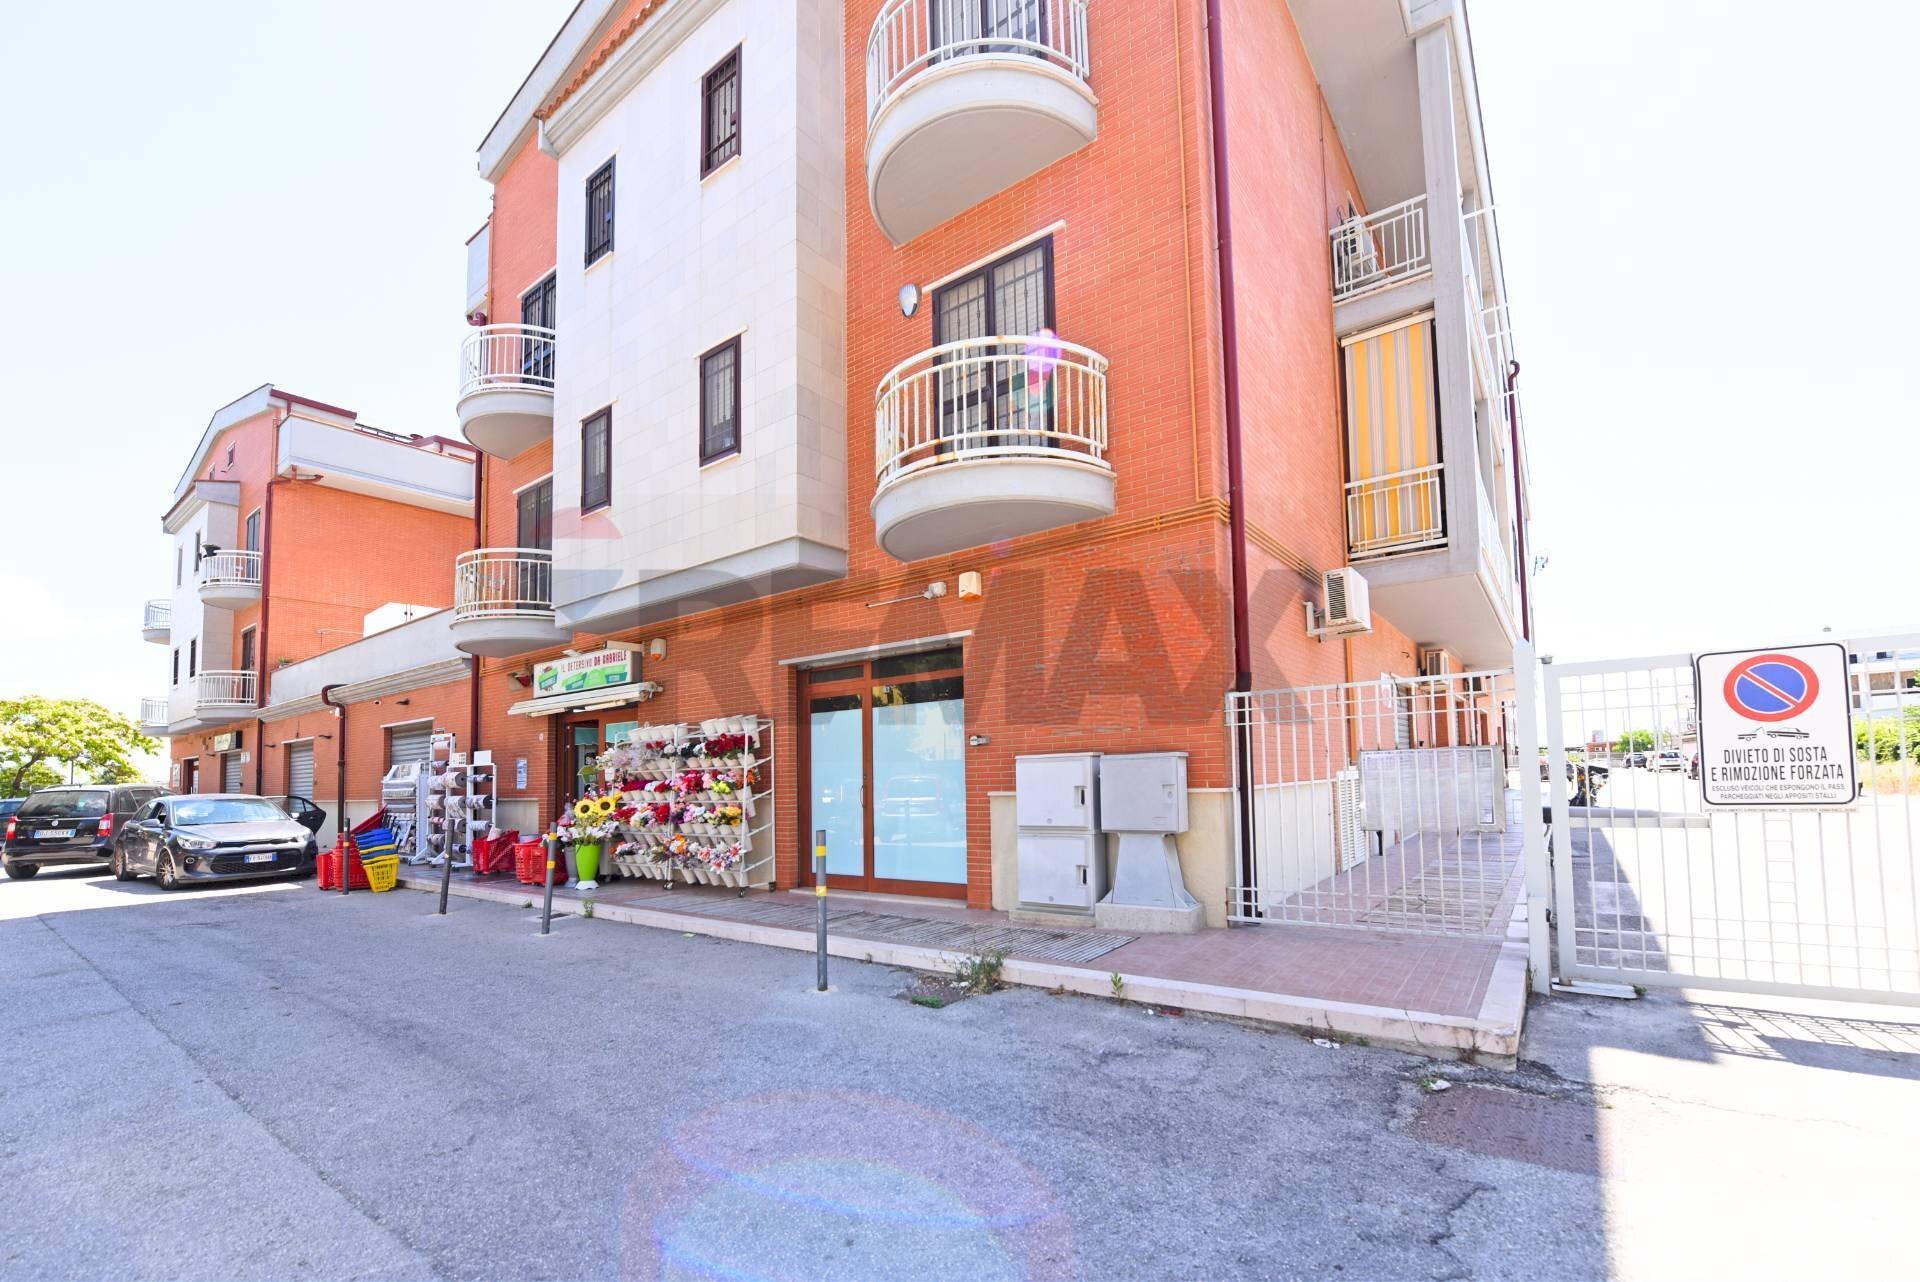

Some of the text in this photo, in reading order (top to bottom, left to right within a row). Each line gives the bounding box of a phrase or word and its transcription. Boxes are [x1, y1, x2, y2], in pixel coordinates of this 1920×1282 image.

[567, 657, 593, 672] DETERSIVO
[1723, 746, 1828, 764] DIVIETO DI SOSTA
[1711, 764, 1844, 781] E RIMOZIONE FORZATA
[1740, 784, 1764, 792] VEICOLI
[1765, 784, 1778, 792] CHE
[1766, 792, 1783, 800] NEGLI
[1785, 792, 1814, 800] APPOSITI
